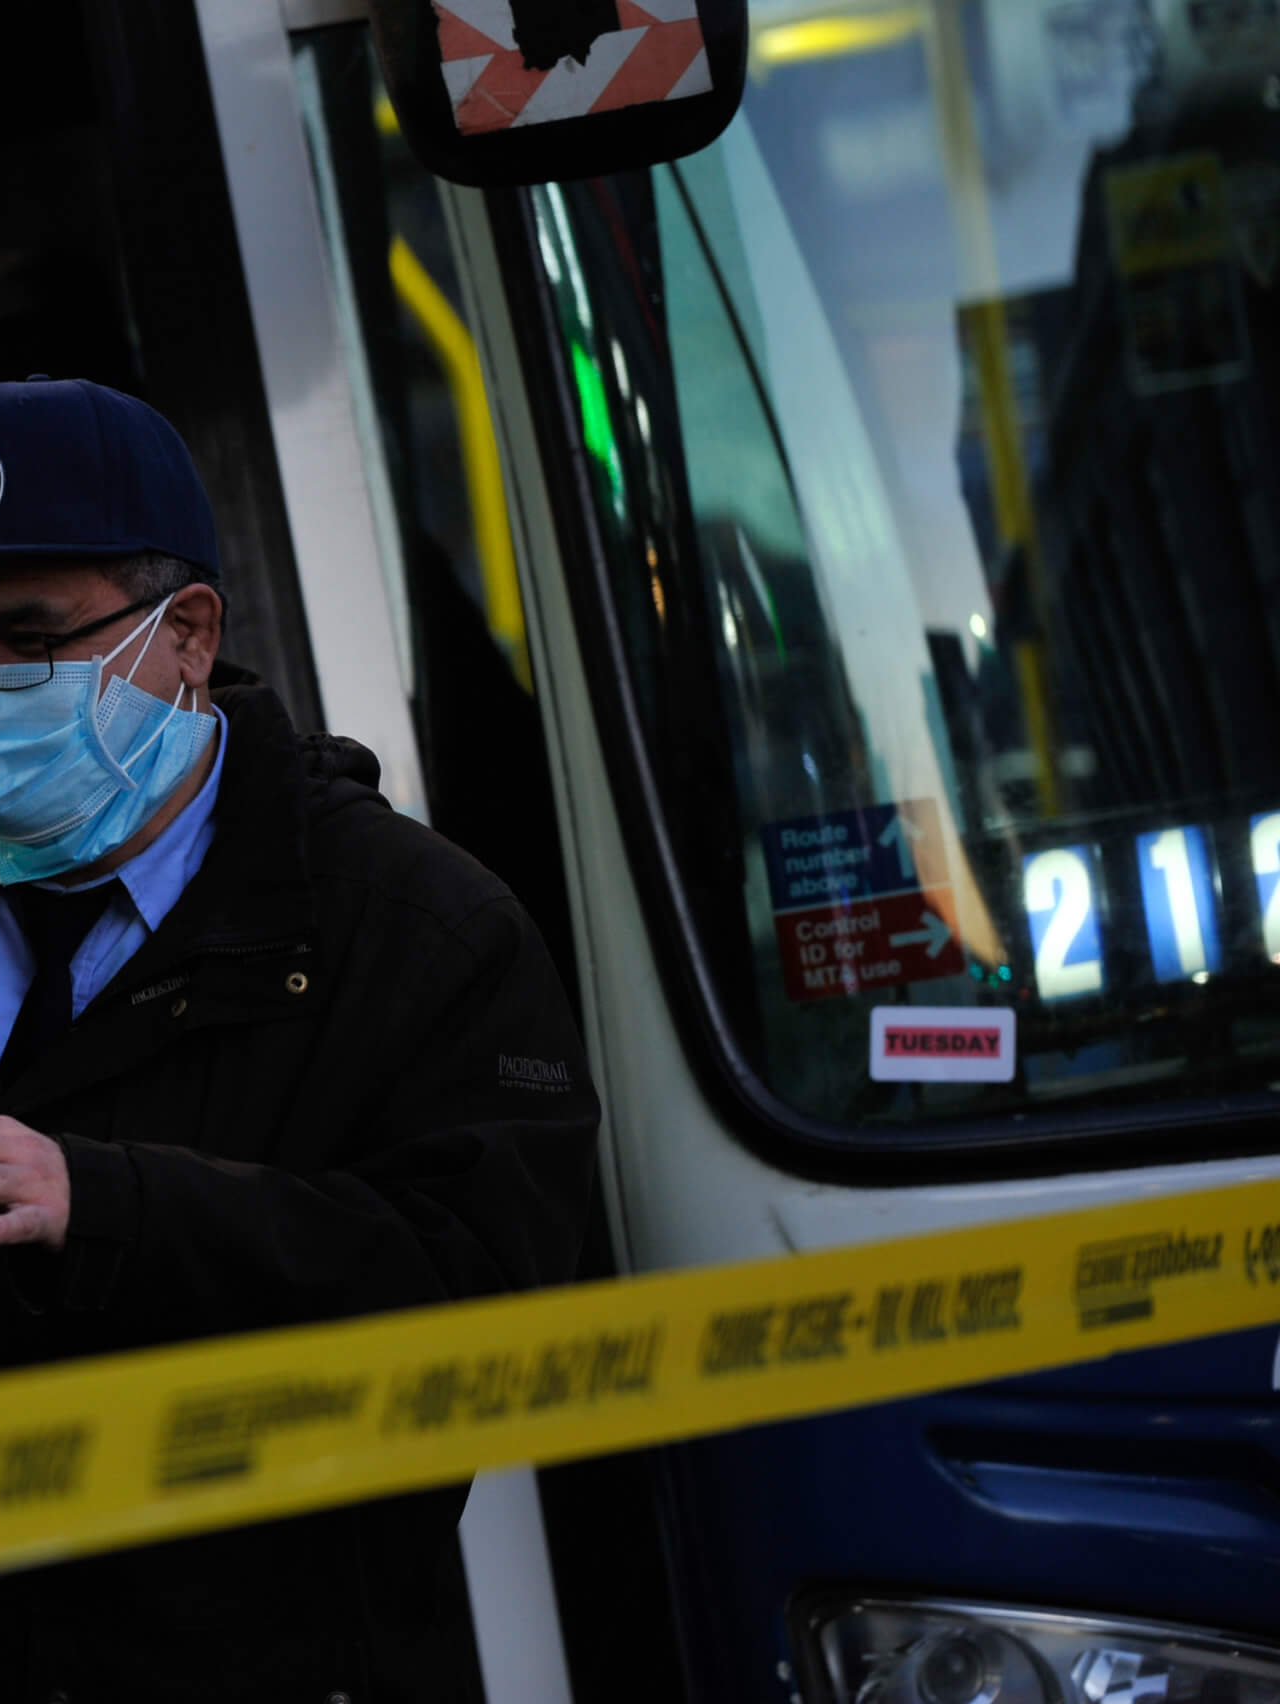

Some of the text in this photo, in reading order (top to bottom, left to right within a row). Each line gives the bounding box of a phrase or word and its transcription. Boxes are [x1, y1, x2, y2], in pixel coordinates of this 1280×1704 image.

[780, 823, 849, 849] Route
[785, 845, 870, 873] number
[789, 872, 858, 897] above
[796, 911, 880, 941] Control
[800, 940, 865, 965] ID for
[804, 959, 902, 989] MTA use
[886, 1033, 1001, 1052] TUESDAY
